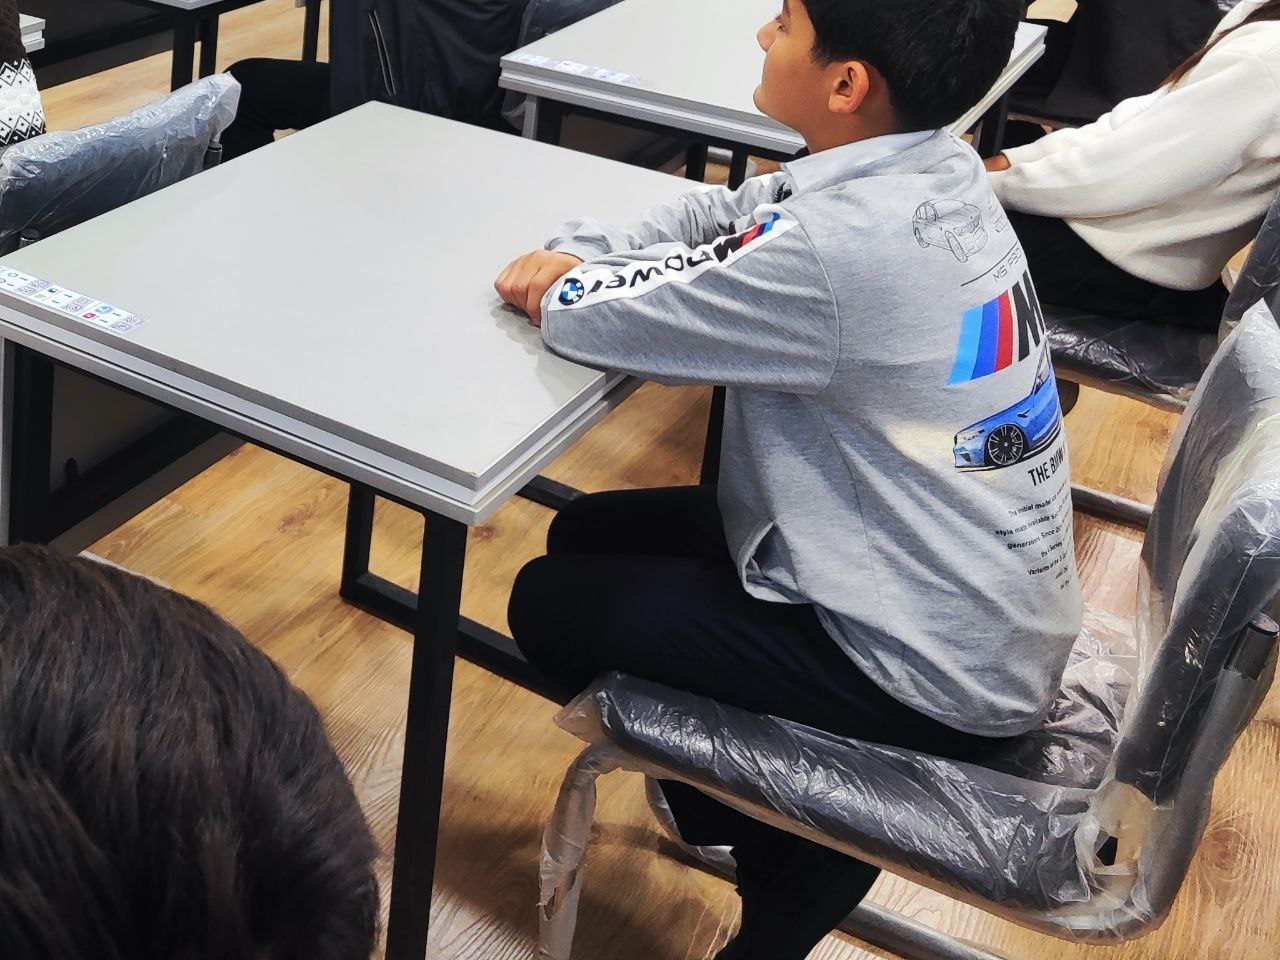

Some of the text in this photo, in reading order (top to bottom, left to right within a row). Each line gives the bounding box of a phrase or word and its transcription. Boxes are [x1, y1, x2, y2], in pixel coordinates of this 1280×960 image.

[1011, 268, 1047, 363] M
[1027, 462, 1050, 486] THE
[1017, 503, 1034, 514] initial
